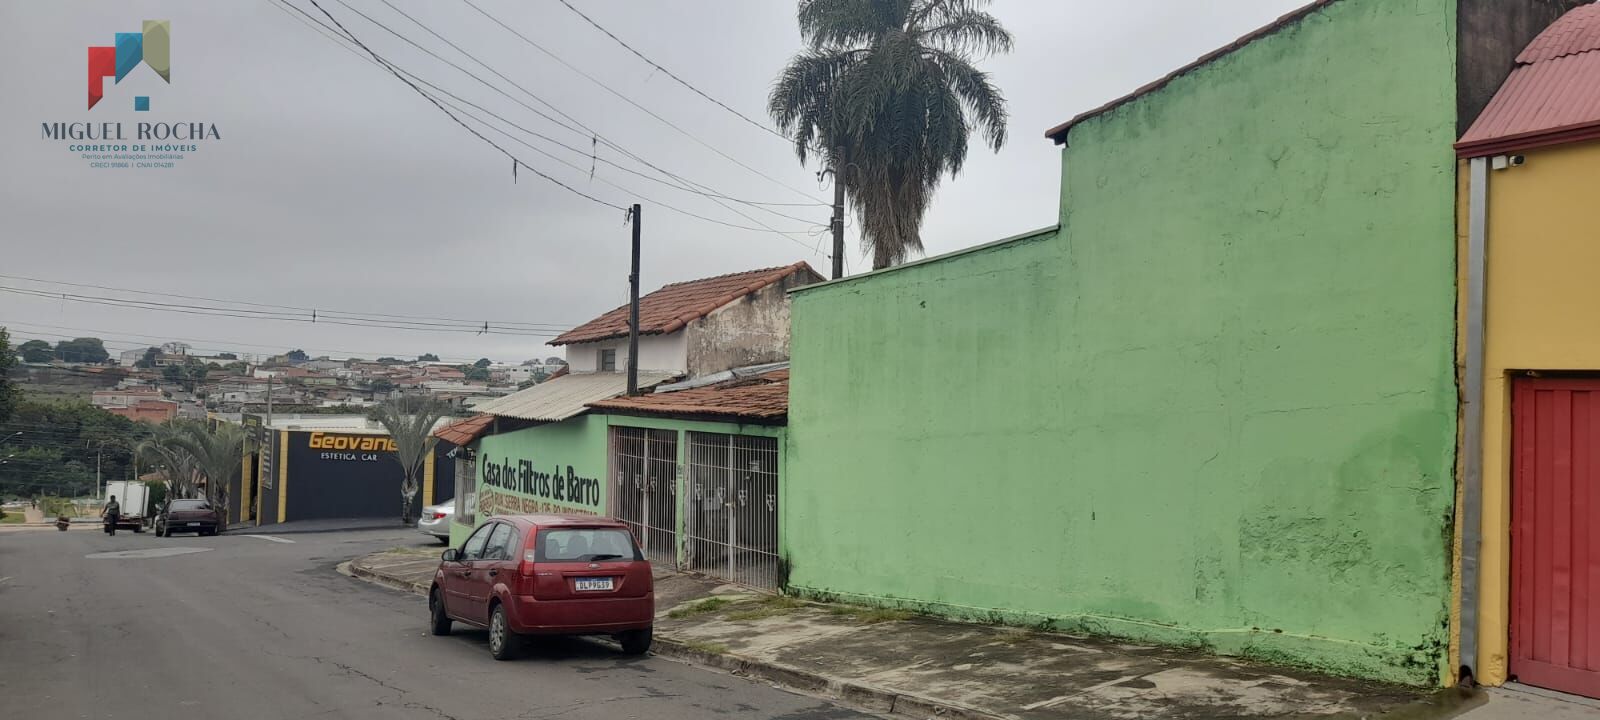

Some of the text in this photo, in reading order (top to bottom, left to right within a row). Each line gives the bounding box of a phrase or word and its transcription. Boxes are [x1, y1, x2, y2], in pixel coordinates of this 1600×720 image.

[482, 453, 600, 506] Casa dos Filtros de Barro
